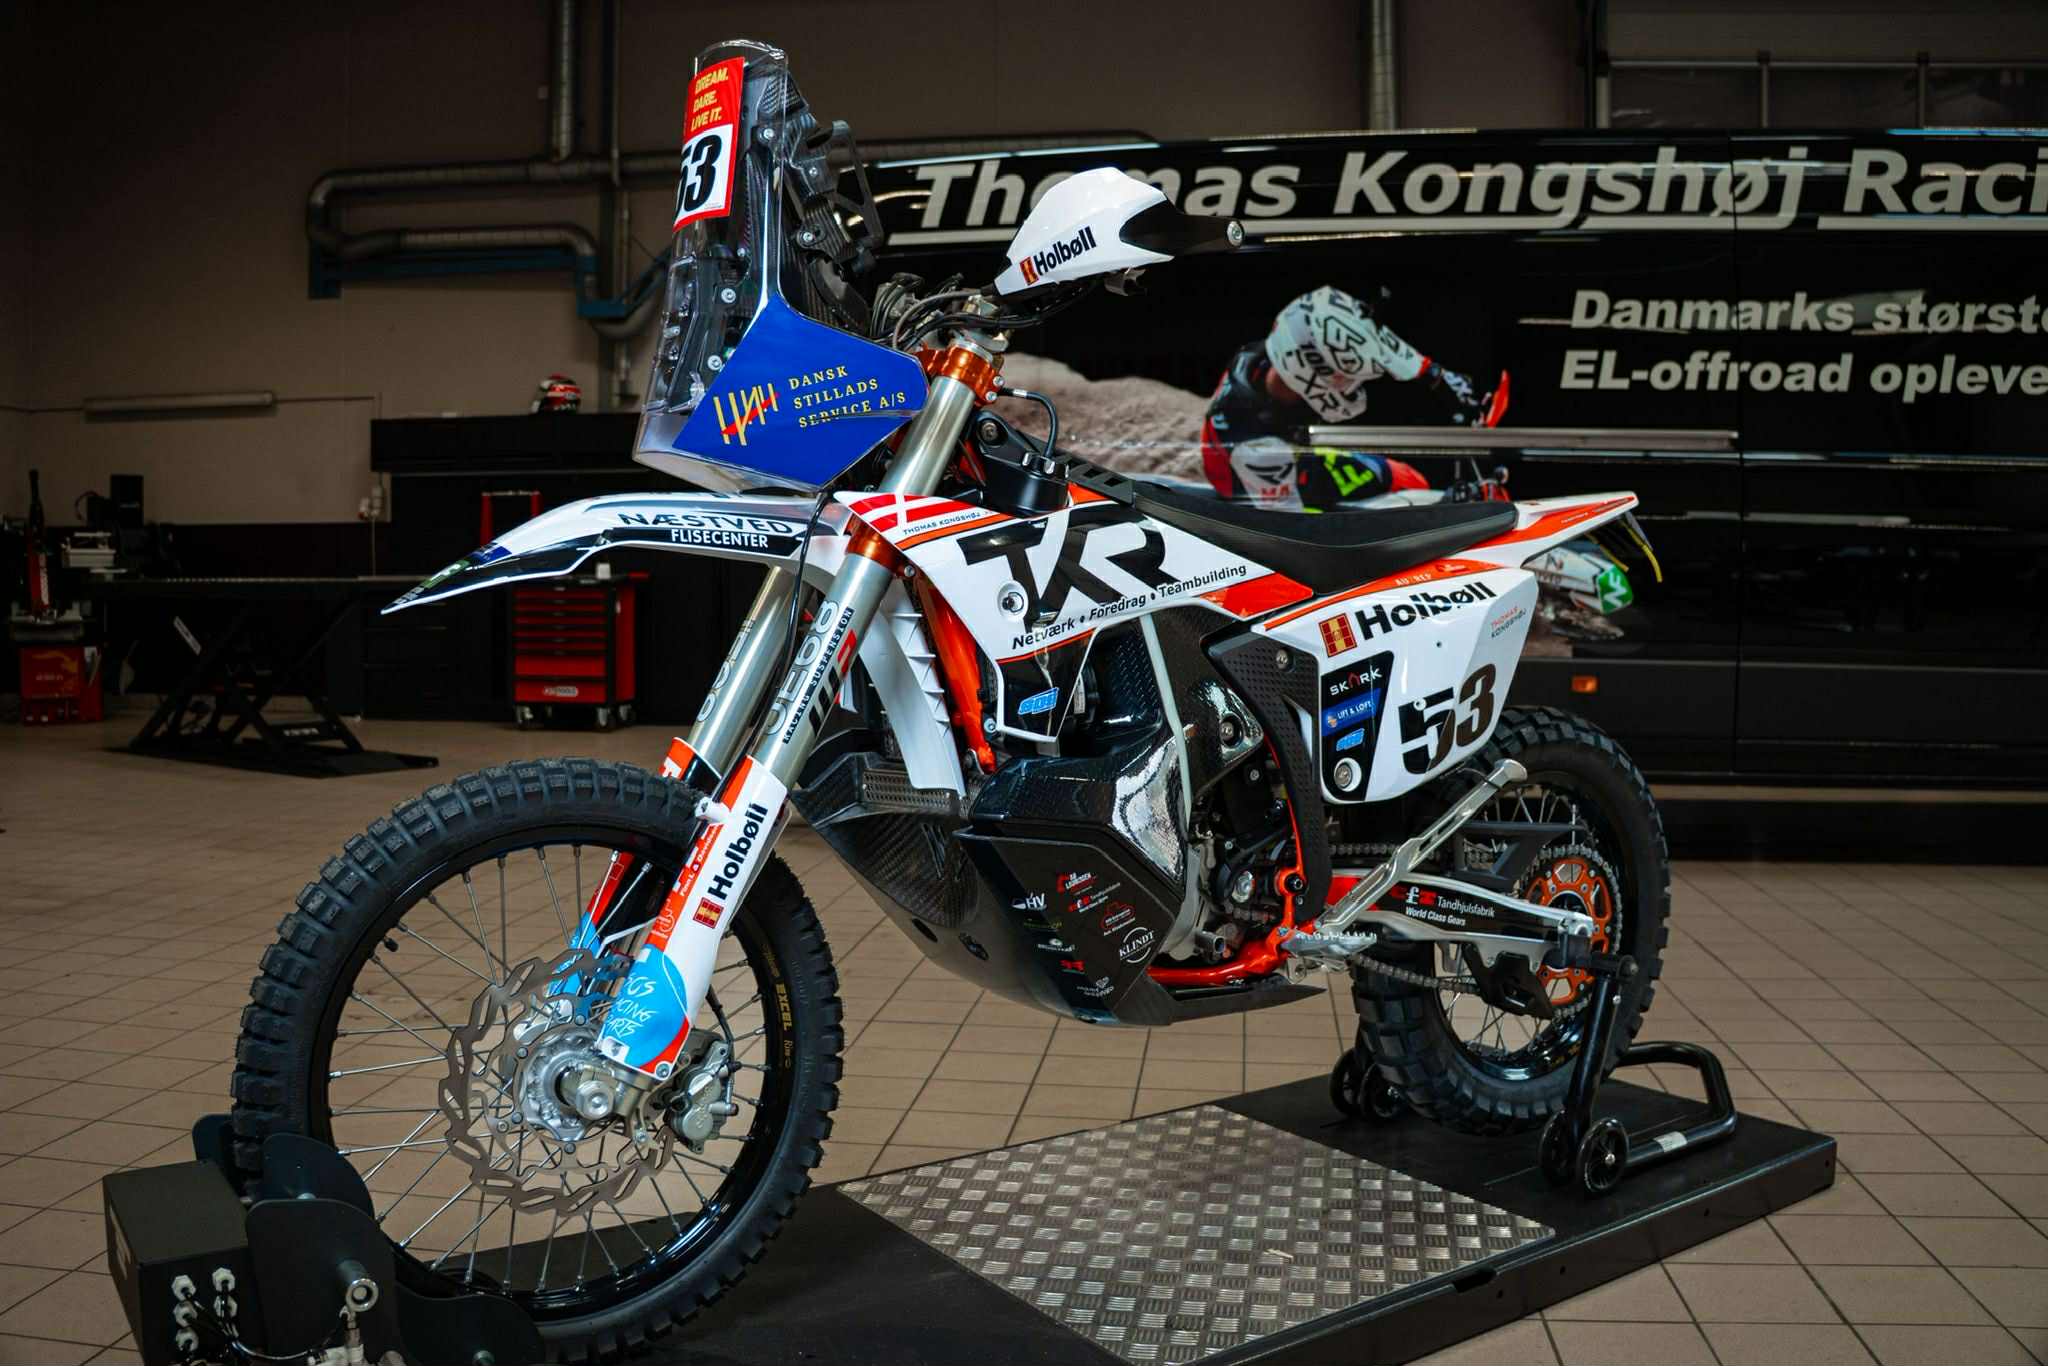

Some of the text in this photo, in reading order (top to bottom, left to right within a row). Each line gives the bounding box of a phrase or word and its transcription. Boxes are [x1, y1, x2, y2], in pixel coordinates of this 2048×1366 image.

[695, 67, 729, 94] DREAM.
[693, 90, 717, 113] DARE.
[691, 110, 709, 132] LIVE
[912, 161, 1300, 229] Thas
[1333, 146, 1807, 229] Kongshøj
[1033, 226, 1097, 276] Holbøll
[1570, 289, 2048, 333] Danmarks størst
[788, 365, 849, 390] DANSK
[1560, 350, 1853, 392] EL-offroad
[793, 378, 879, 409] STILLADS
[798, 392, 906, 428] SERVICE A/S
[618, 512, 794, 535] NÆSTVED
[904, 521, 938, 535] THOMAS
[671, 528, 769, 548] FLISECENTER
[1012, 564, 1247, 650] Netværk Foredrag Teambuilding
[1355, 581, 1497, 641] Holbøll
[810, 606, 854, 686] SUSPENSION
[1398, 663, 1497, 775] 53
[707, 802, 769, 901] Holbøll
[1405, 906, 1466, 926] World Class Gears
[1437, 895, 1495, 918] Tandhjulsfabrik
[1119, 929, 1155, 957] KLINDT
[614, 998, 658, 1026] CING
[608, 1016, 645, 1040] ARTS
